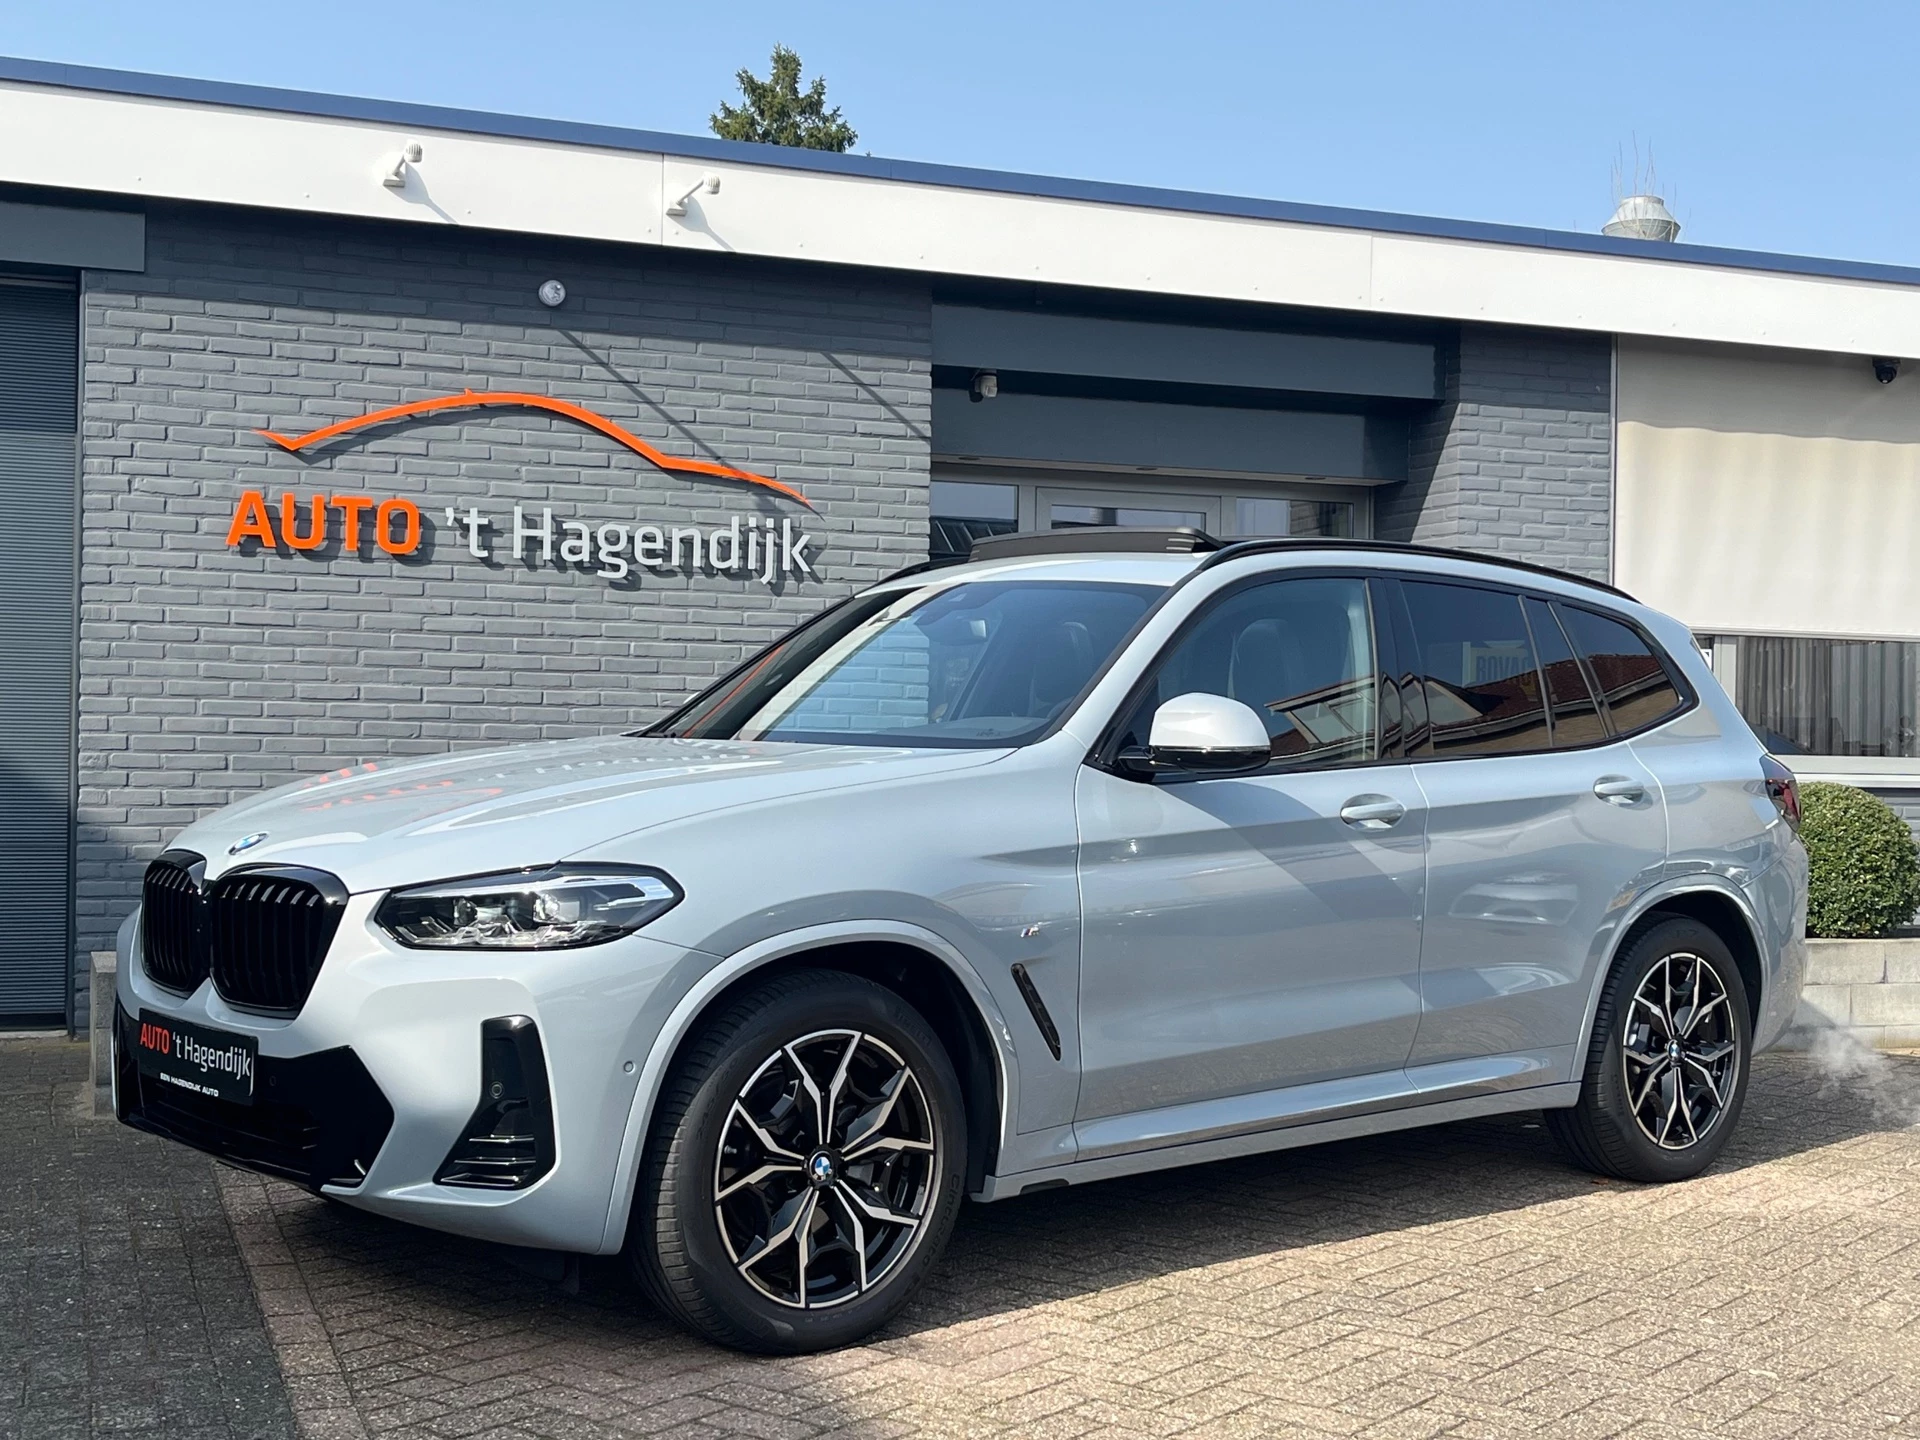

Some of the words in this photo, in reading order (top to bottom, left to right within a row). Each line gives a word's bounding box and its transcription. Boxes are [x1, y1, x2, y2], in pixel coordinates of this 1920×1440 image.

[225, 490, 421, 555] AUTO
[445, 506, 489, 559] 't
[512, 507, 812, 584] Hagendijk
[140, 1023, 170, 1055] AUTO
[184, 1035, 251, 1080] Hagendijk
[202, 1086, 219, 1097] AUTO
